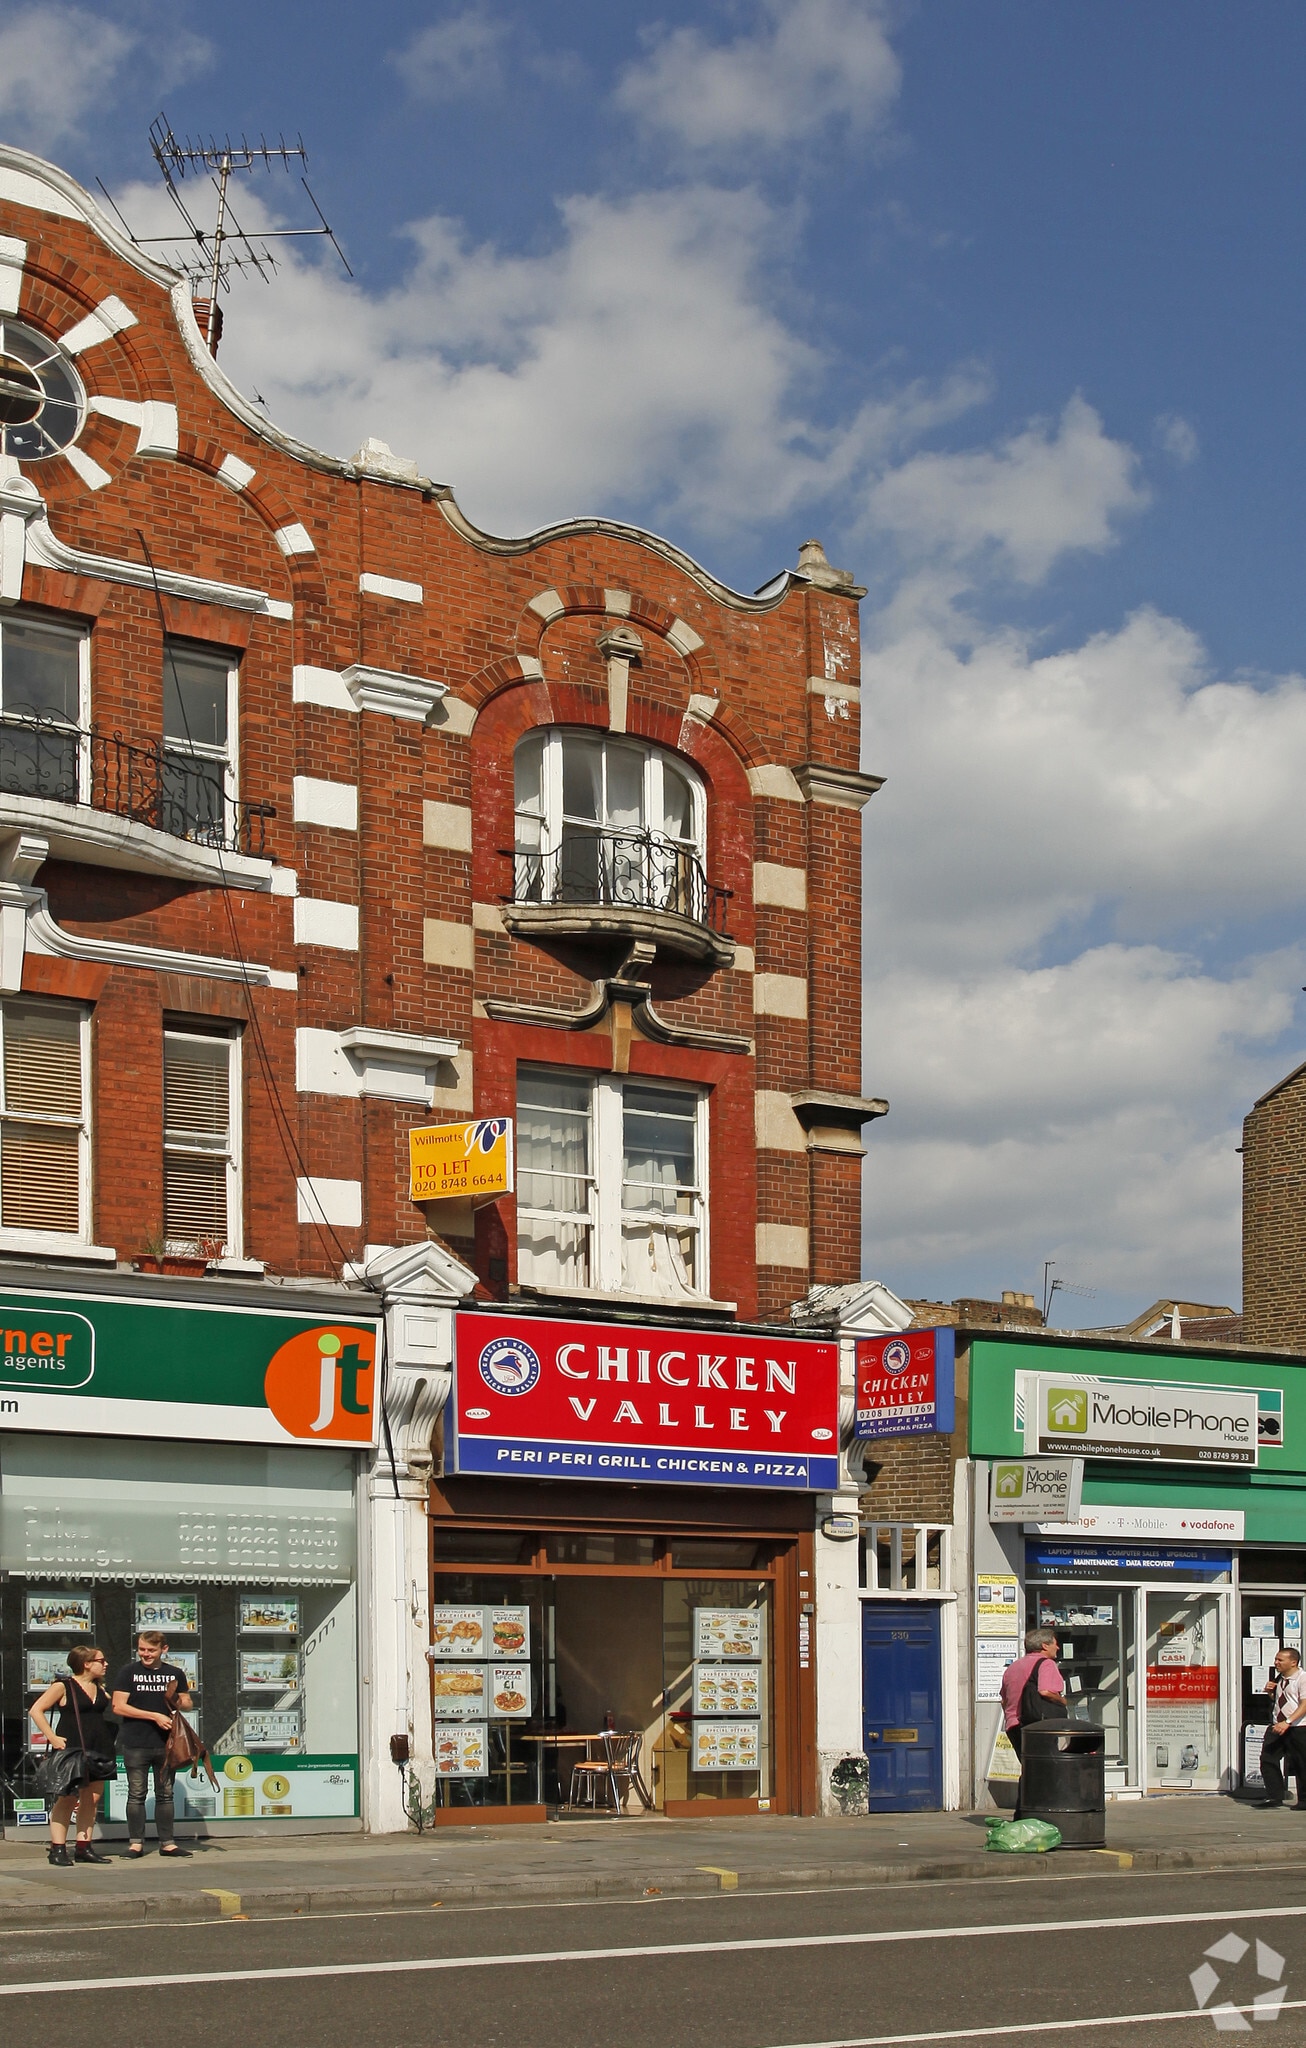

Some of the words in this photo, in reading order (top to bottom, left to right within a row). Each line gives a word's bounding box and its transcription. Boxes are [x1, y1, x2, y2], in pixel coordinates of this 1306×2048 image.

[415, 1133, 462, 1146] Willmotts
[416, 1164, 436, 1178] TO
[443, 1160, 470, 1176] LET
[414, 1181, 436, 1192] 020
[441, 1177, 467, 1189] 8748
[472, 1173, 503, 1186] 6644
[0, 1328, 73, 1357] ner
[482, 1341, 509, 1367] CHICKEN
[512, 1342, 537, 1368] VALLEY
[860, 1358, 876, 1366] HALAL
[4, 1355, 66, 1371] agents
[555, 1343, 797, 1395] CHICKEN
[309, 1333, 371, 1433] jt
[862, 1374, 930, 1394] CHICKEN
[868, 1392, 924, 1407] VALLEY
[1092, 1392, 1109, 1401] The
[567, 1396, 788, 1434] VALLEY
[860, 1410, 882, 1419] 0208
[888, 1407, 904, 1416] 127
[910, 1404, 932, 1414] 1769
[1224, 1434, 1249, 1442] House
[1047, 1442, 1160, 1456] www.mobilephonehouse.co.uk
[1213, 1452, 1229, 1460] 8749
[1230, 1452, 1239, 1460] 99
[1240, 1453, 1249, 1461] 33
[496, 1449, 543, 1464] PERI
[548, 1452, 592, 1466] PERI
[598, 1455, 651, 1470] GRILL
[656, 1458, 734, 1473] CHICKEN
[736, 1462, 749, 1474] &
[754, 1463, 808, 1477] PIZZA
[1026, 1470, 1067, 1482] Mobile
[1026, 1482, 1067, 1494] Phone
[1190, 1520, 1235, 1530] vodafone
[24, 1569, 334, 1588] www.jorgensenturner.com
[891, 1632, 909, 1640] 230
[1181, 1672, 1216, 1680] Phone
[504, 1681, 514, 1689] £1
[1147, 1684, 1176, 1692] epair
